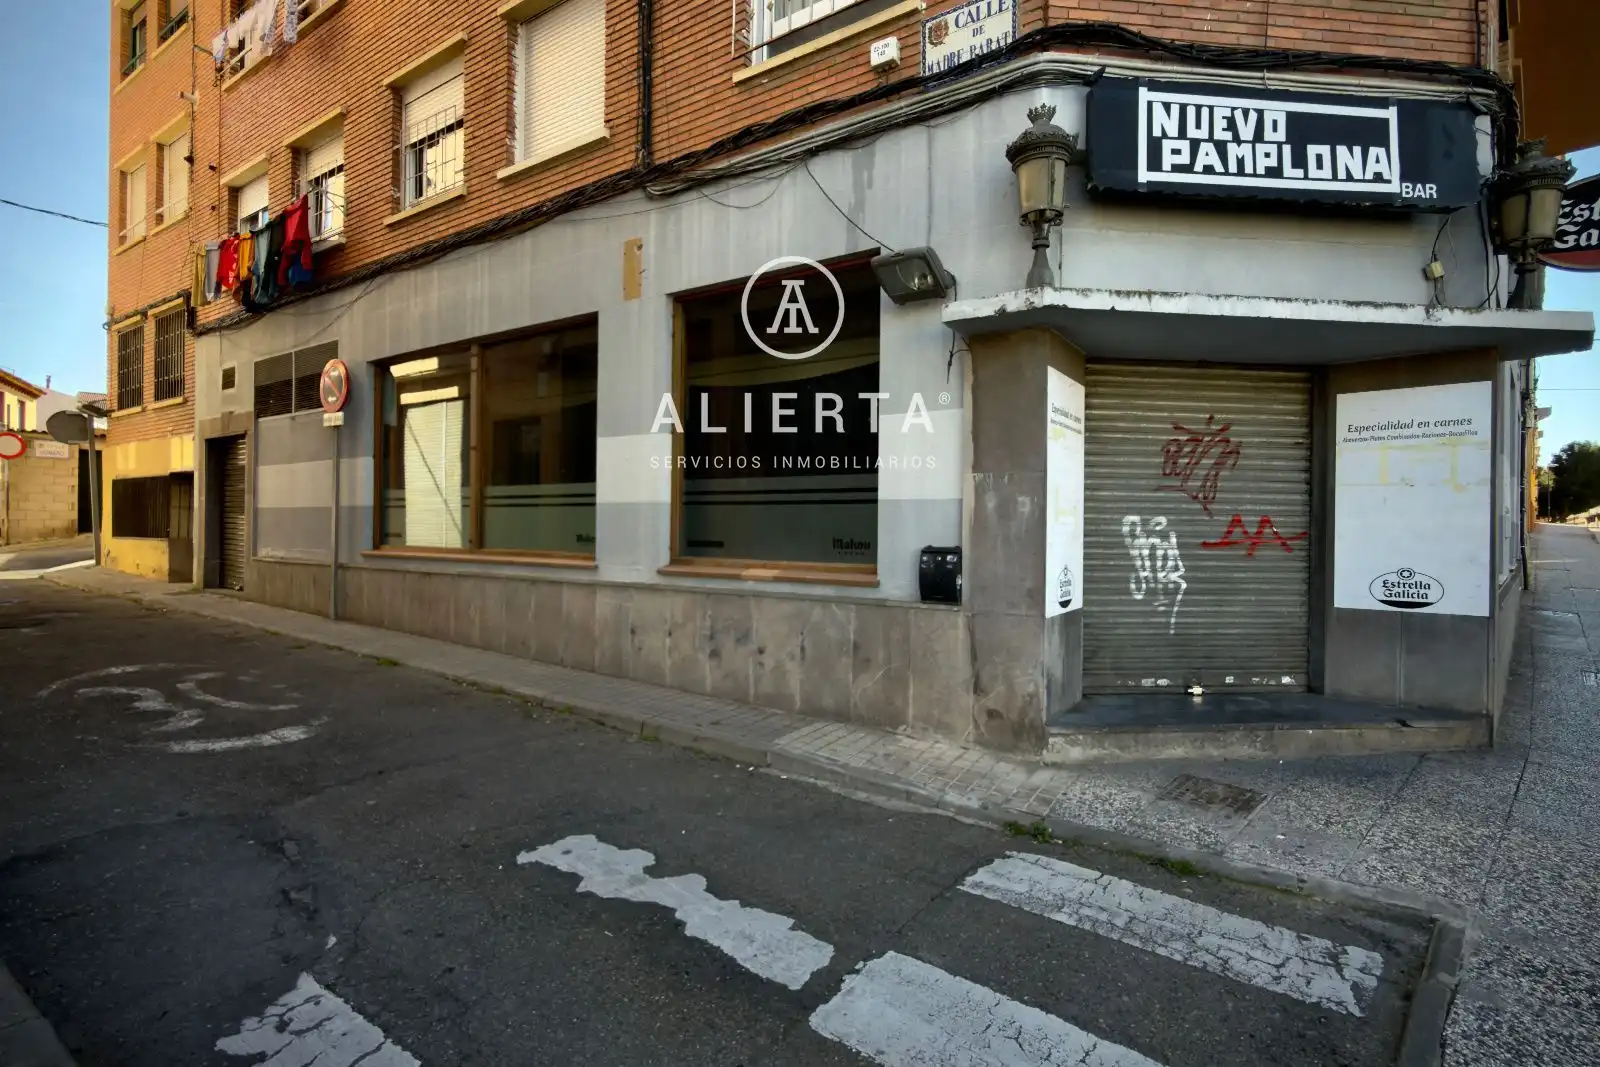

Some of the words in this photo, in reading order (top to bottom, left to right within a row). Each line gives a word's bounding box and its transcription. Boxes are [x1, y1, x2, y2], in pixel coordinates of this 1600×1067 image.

[955, 0, 1010, 29] CALLE
[972, 24, 986, 38] DE
[927, 48, 964, 74] MADRE
[1152, 101, 1287, 142] NUEVO
[1161, 138, 1393, 180] PAMPLONA
[1401, 183, 1438, 200] BAR
[1347, 418, 1414, 435] Especialidad
[1417, 420, 1430, 429] en
[1433, 416, 1473, 428] carnes
[1381, 579, 1431, 590] Estrella
[1383, 588, 1429, 600] Galicia
